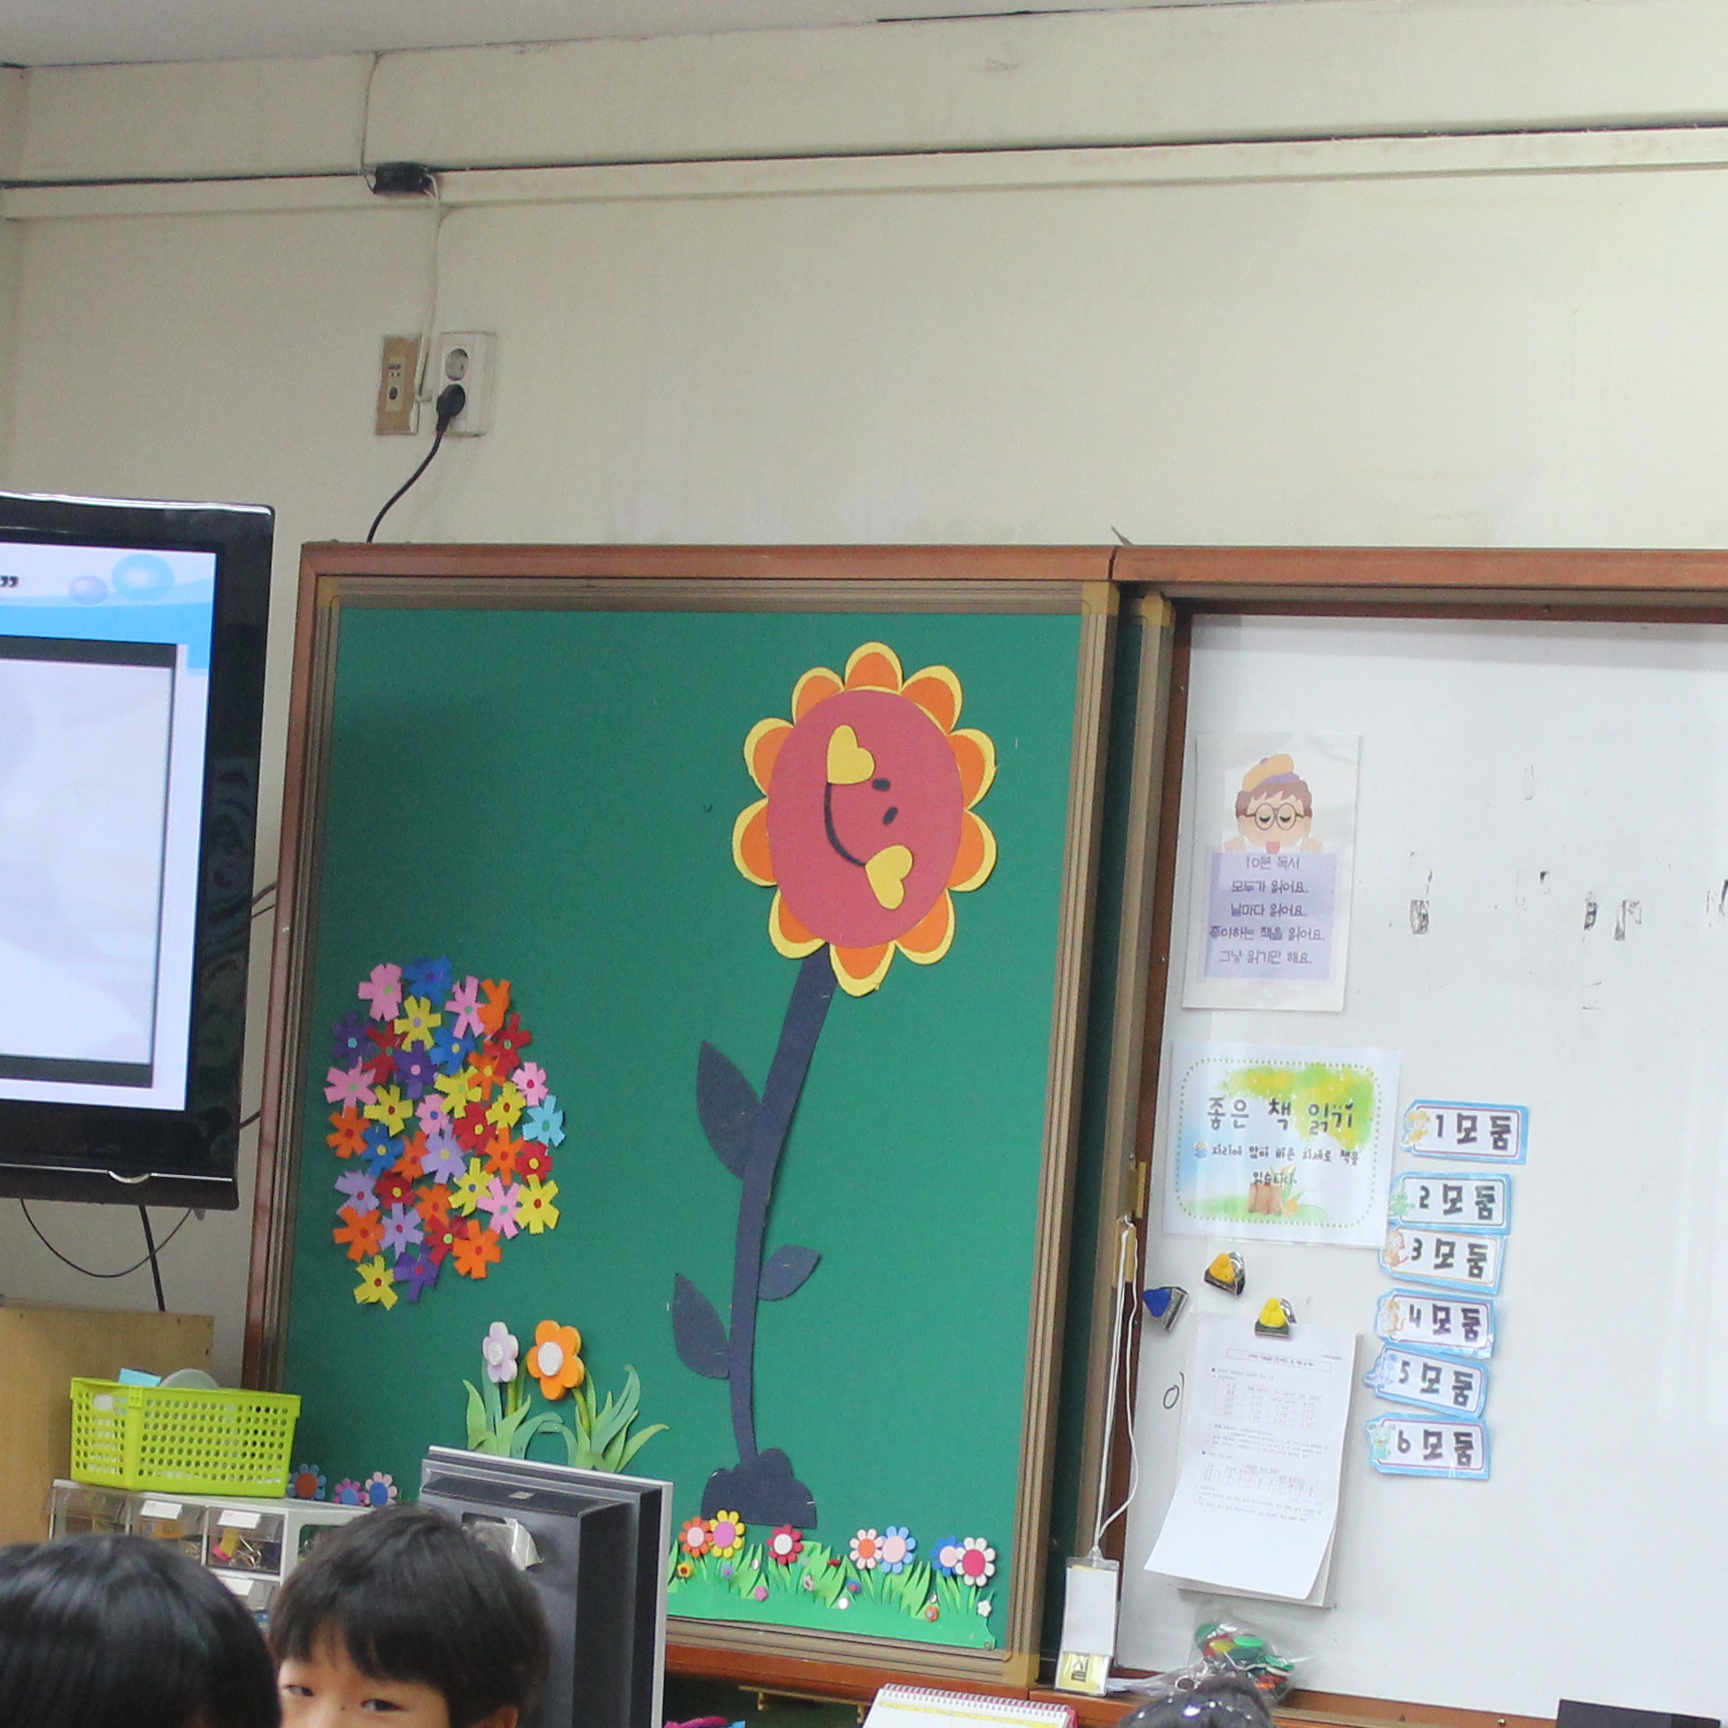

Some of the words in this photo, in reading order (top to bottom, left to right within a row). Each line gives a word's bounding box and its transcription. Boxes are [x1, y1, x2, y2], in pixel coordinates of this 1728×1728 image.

[1245, 856, 1271, 870] 10분
[1277, 857, 1300, 870] 독서
[1231, 880, 1265, 892] 모두가
[1271, 880, 1308, 893] 읽어요.
[1270, 903, 1307, 916] 읽어요.
[1210, 926, 1254, 940] 좋아하는
[1260, 926, 1282, 941] 책을
[1219, 950, 1242, 963] 그냥
[1247, 950, 1281, 964] 읽기만
[1207, 1097, 1249, 1130] 좋은
[1268, 1098, 1291, 1131] 책
[1307, 1102, 1354, 1135] 읽기
[1212, 1144, 1242, 1156] 자리에
[1275, 1148, 1296, 1161] 바른
[1339, 1150, 1360, 1165] 책을
